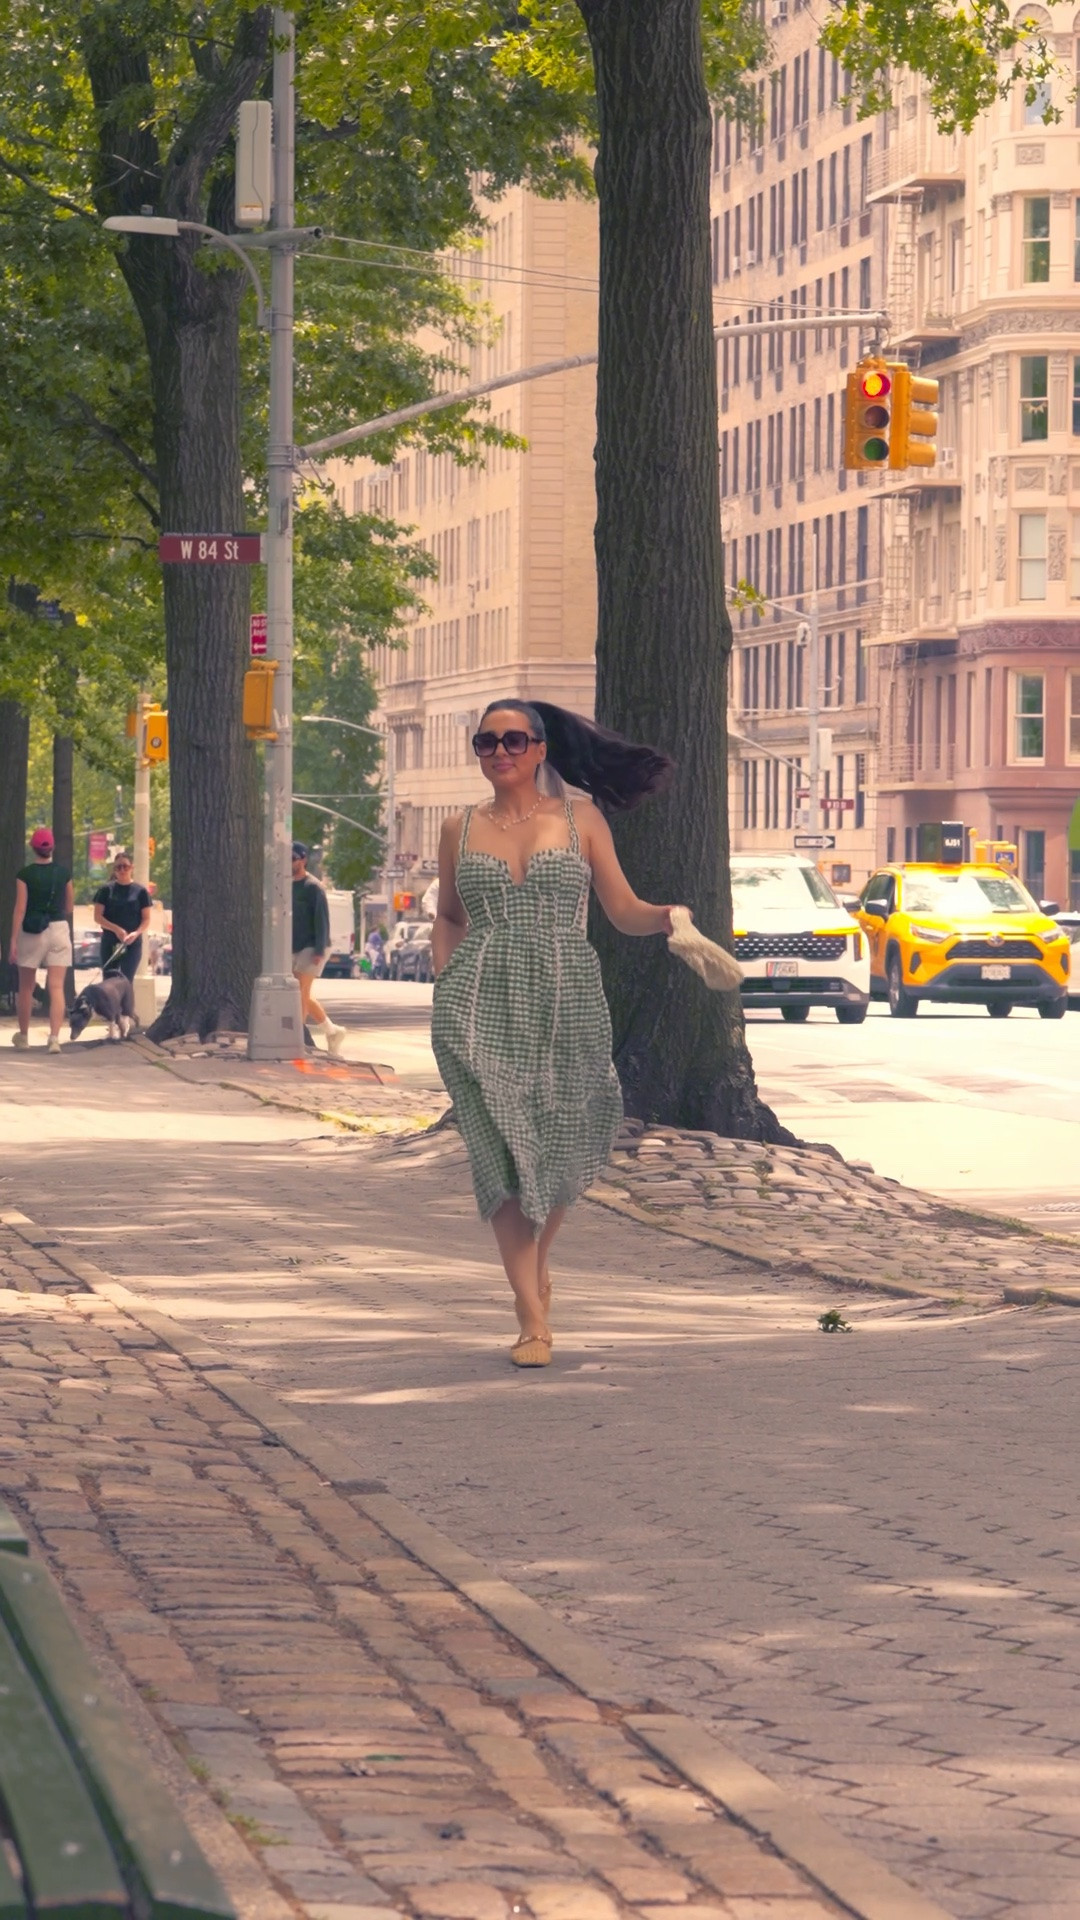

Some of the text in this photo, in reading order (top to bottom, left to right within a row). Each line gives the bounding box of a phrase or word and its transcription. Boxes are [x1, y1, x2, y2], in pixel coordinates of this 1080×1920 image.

[181, 540, 239, 560] W 84 St
